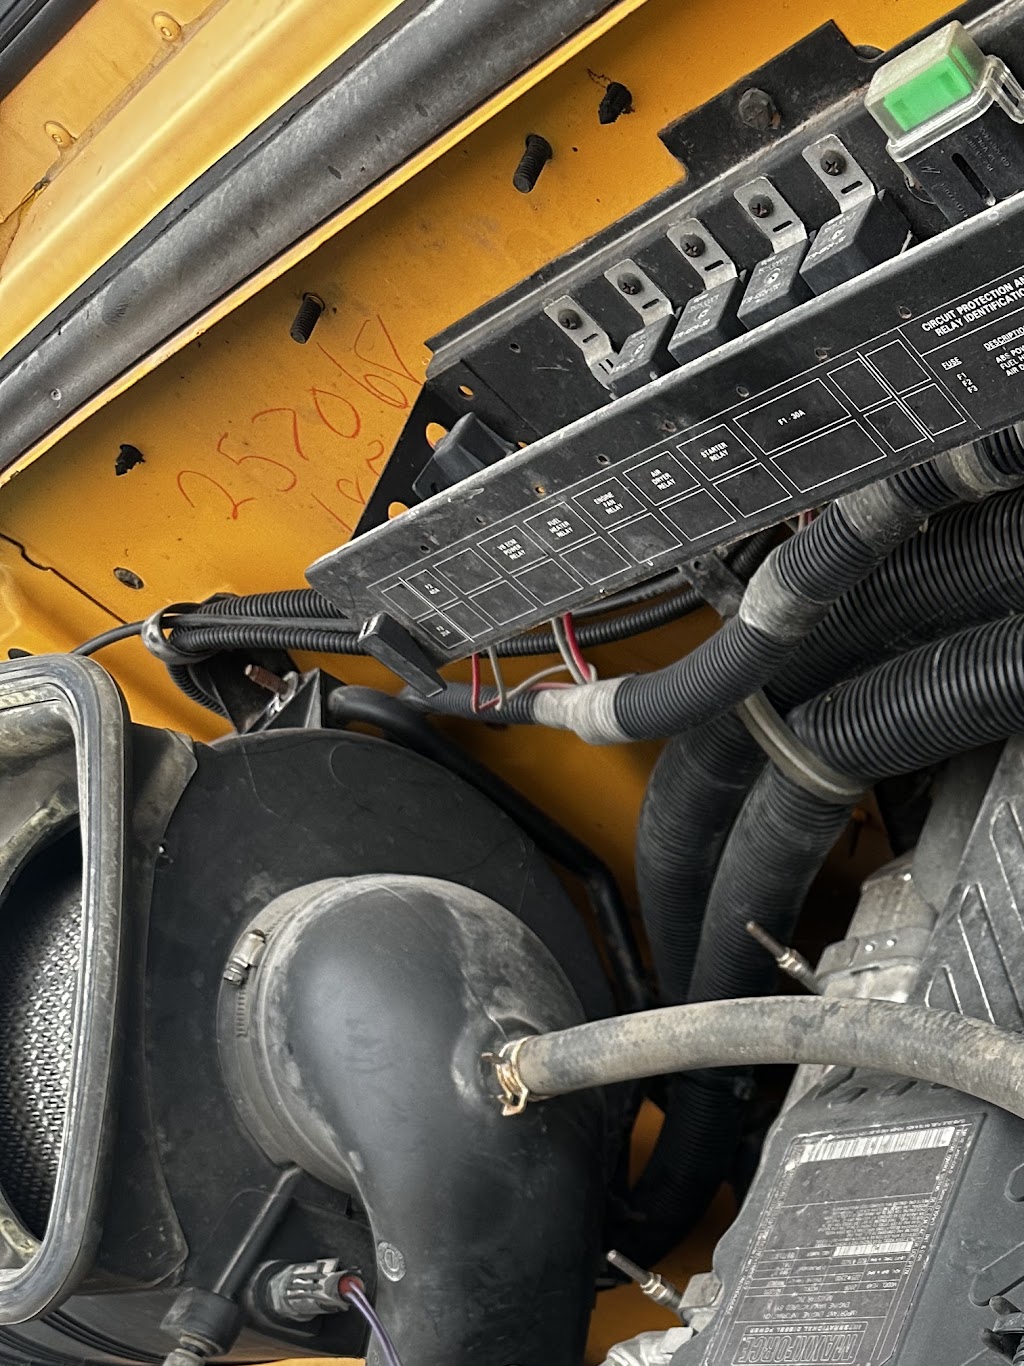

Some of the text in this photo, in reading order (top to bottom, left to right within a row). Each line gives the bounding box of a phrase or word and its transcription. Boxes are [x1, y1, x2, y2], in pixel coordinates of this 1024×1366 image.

[921, 309, 957, 332] CIRCUIT
[958, 282, 1014, 315] PROTECTION
[935, 318, 964, 337] RELAY
[942, 357, 962, 370] FUSE
[1000, 358, 1018, 370] FUEL
[957, 372, 967, 381] F1
[1006, 364, 1020, 377] AIR
[962, 378, 973, 388] F2
[778, 417, 788, 426] F1
[790, 409, 806, 421] 30A
[700, 442, 728, 458] STARTER
[709, 450, 729, 462] RELAY
[650, 468, 662, 479] AIR
[651, 472, 672, 486] DRYER
[657, 478, 677, 491] RELAY
[593, 491, 615, 505] ENGINE
[602, 499, 616, 509] FAN
[605, 503, 625, 515] RELAY
[547, 517, 561, 527] FUEL
[549, 521, 571, 535] HEATER
[556, 527, 574, 538] RELAY
[503, 544, 522, 556] POWER
[509, 550, 526, 561] RELAY
[800, 1310, 825, 1318] ENGINE
[801, 1323, 863, 1331] INTERNATIONAL
[738, 1334, 858, 1363] MAXXFORCE
